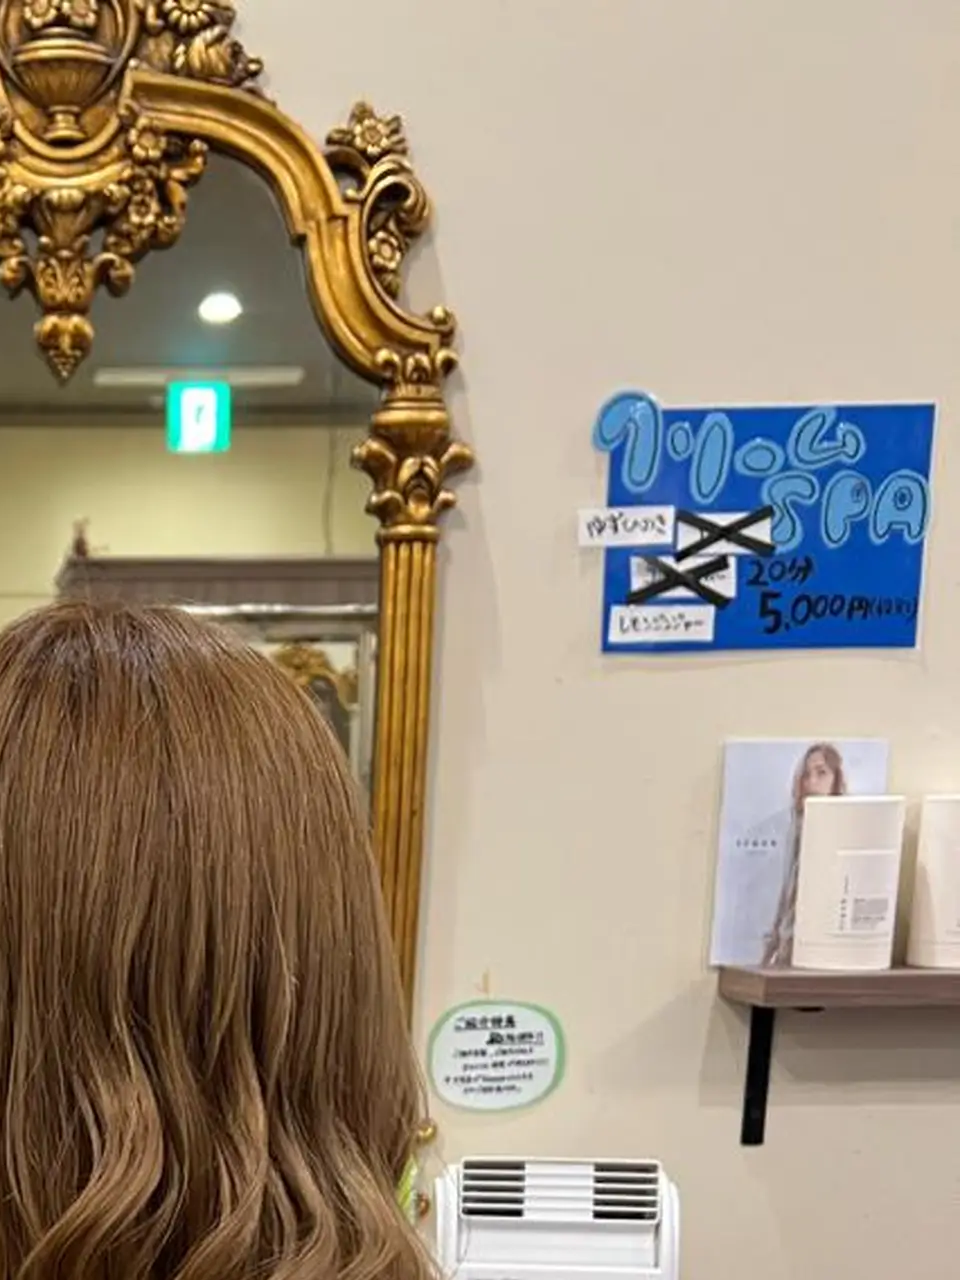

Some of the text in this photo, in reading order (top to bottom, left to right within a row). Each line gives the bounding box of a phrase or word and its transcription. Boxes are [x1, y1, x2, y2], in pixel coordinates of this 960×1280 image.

[593, 391, 867, 504] クリーム
[761, 470, 932, 553] SPA
[746, 556, 814, 586] 20分
